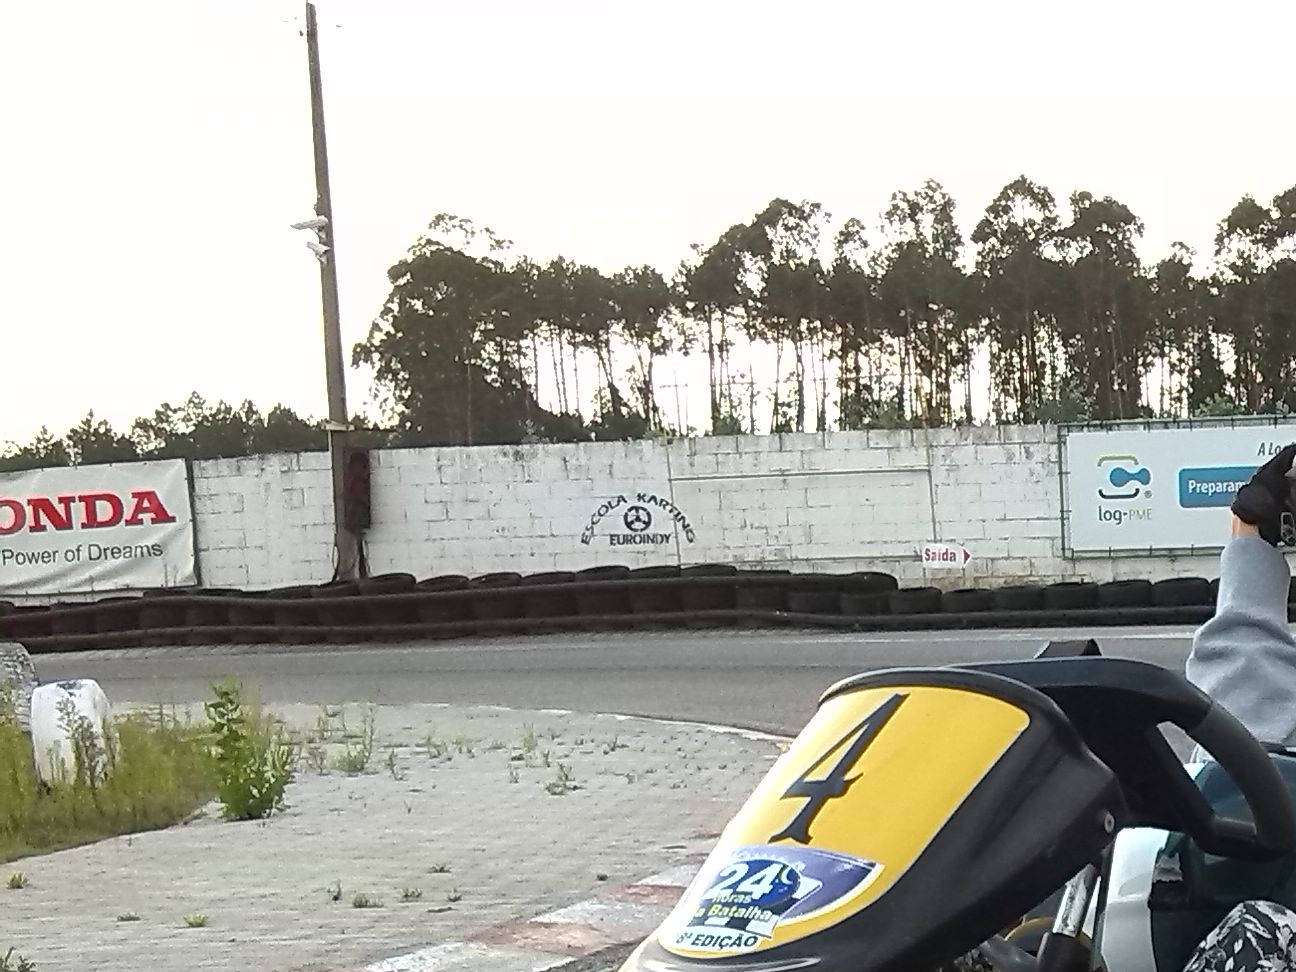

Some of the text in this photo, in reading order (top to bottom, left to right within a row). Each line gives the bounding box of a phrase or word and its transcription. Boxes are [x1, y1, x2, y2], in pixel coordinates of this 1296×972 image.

[581, 493, 696, 546] ESCOLA KARTING
[609, 533, 671, 546] EUROINDY
[2, 541, 163, 567] Power of Dreams
[768, 692, 911, 845] 4
[703, 862, 784, 901] 24
[707, 904, 773, 921] Batalha
[691, 933, 758, 951] EDIÇÃO
